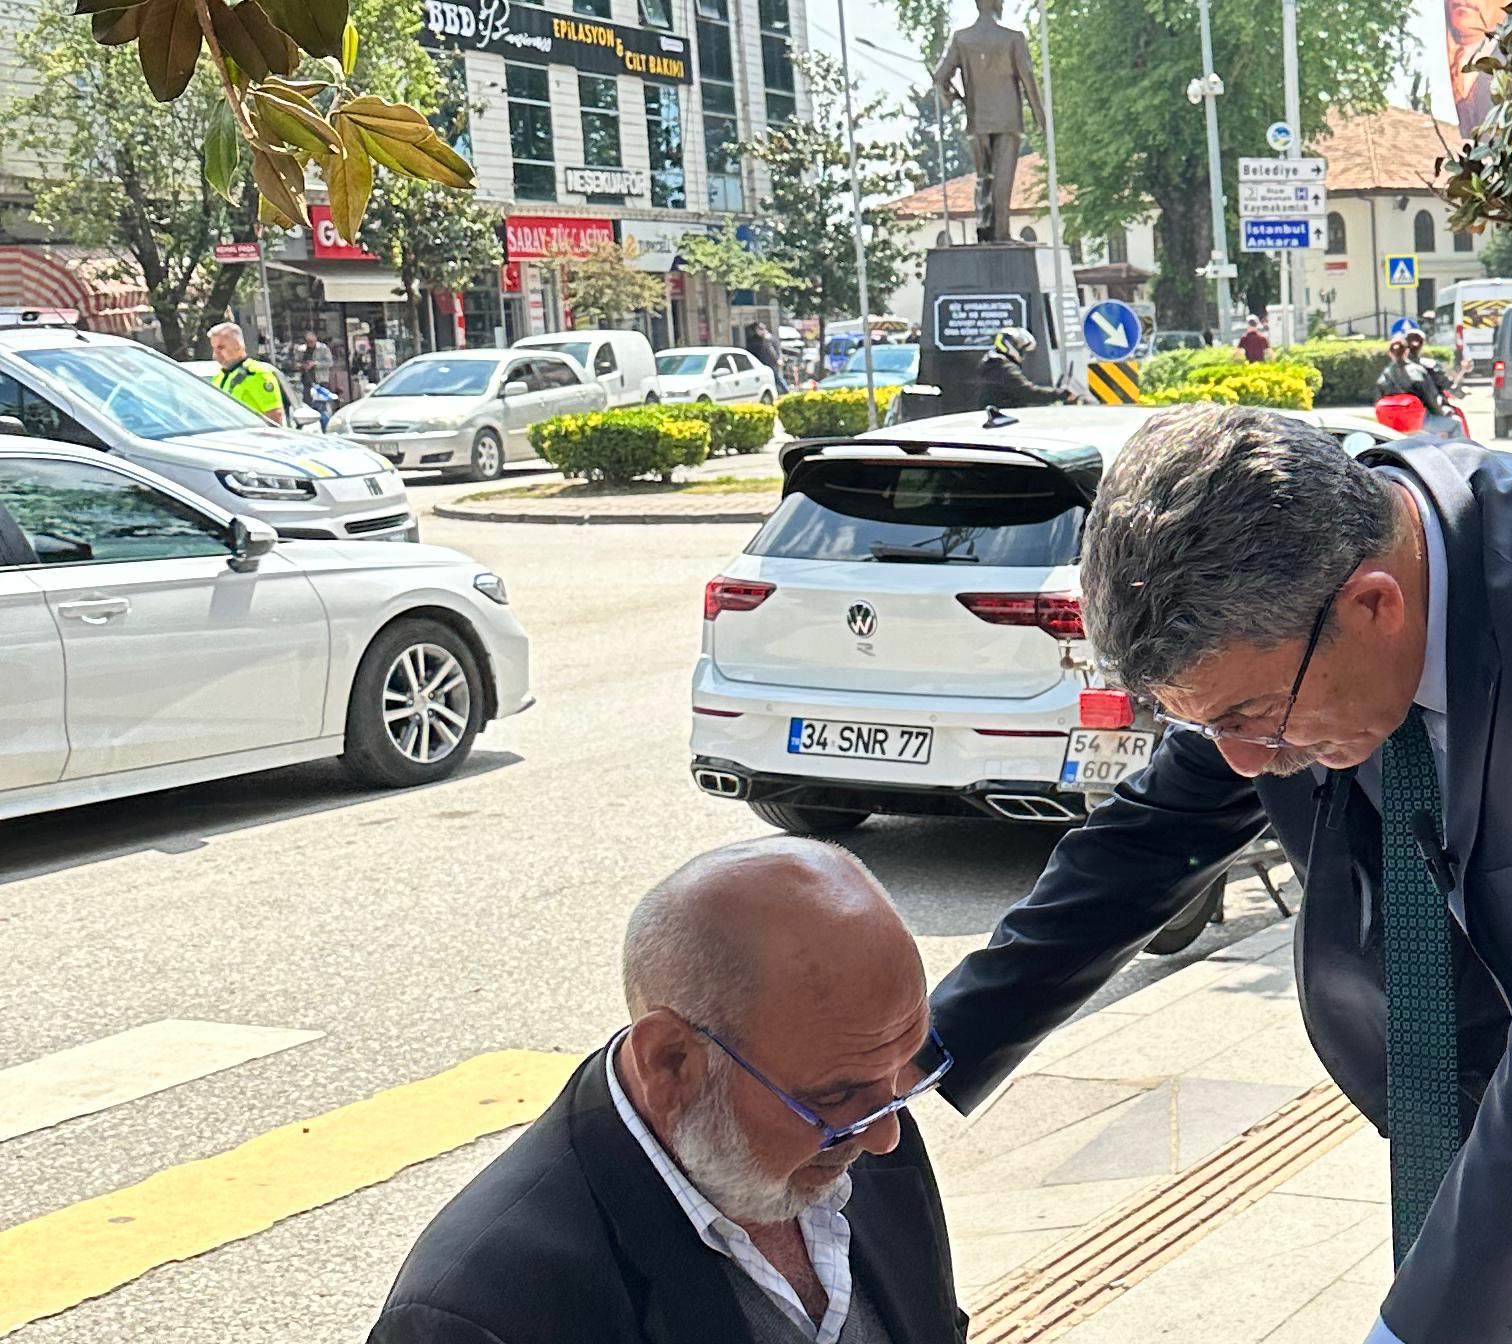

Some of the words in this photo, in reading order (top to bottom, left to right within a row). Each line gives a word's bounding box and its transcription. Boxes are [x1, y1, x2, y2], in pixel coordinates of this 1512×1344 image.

[1243, 164, 1299, 179] Belediye
[506, 225, 547, 253] SARAY
[1246, 222, 1307, 235] İstanbul
[1247, 237, 1300, 247] Ankara
[802, 722, 829, 751] 34
[837, 726, 889, 757] SNR
[899, 730, 928, 759] 77
[1073, 733, 1100, 753] 54
[1116, 735, 1147, 756] KR
[1082, 760, 1127, 781] 607
